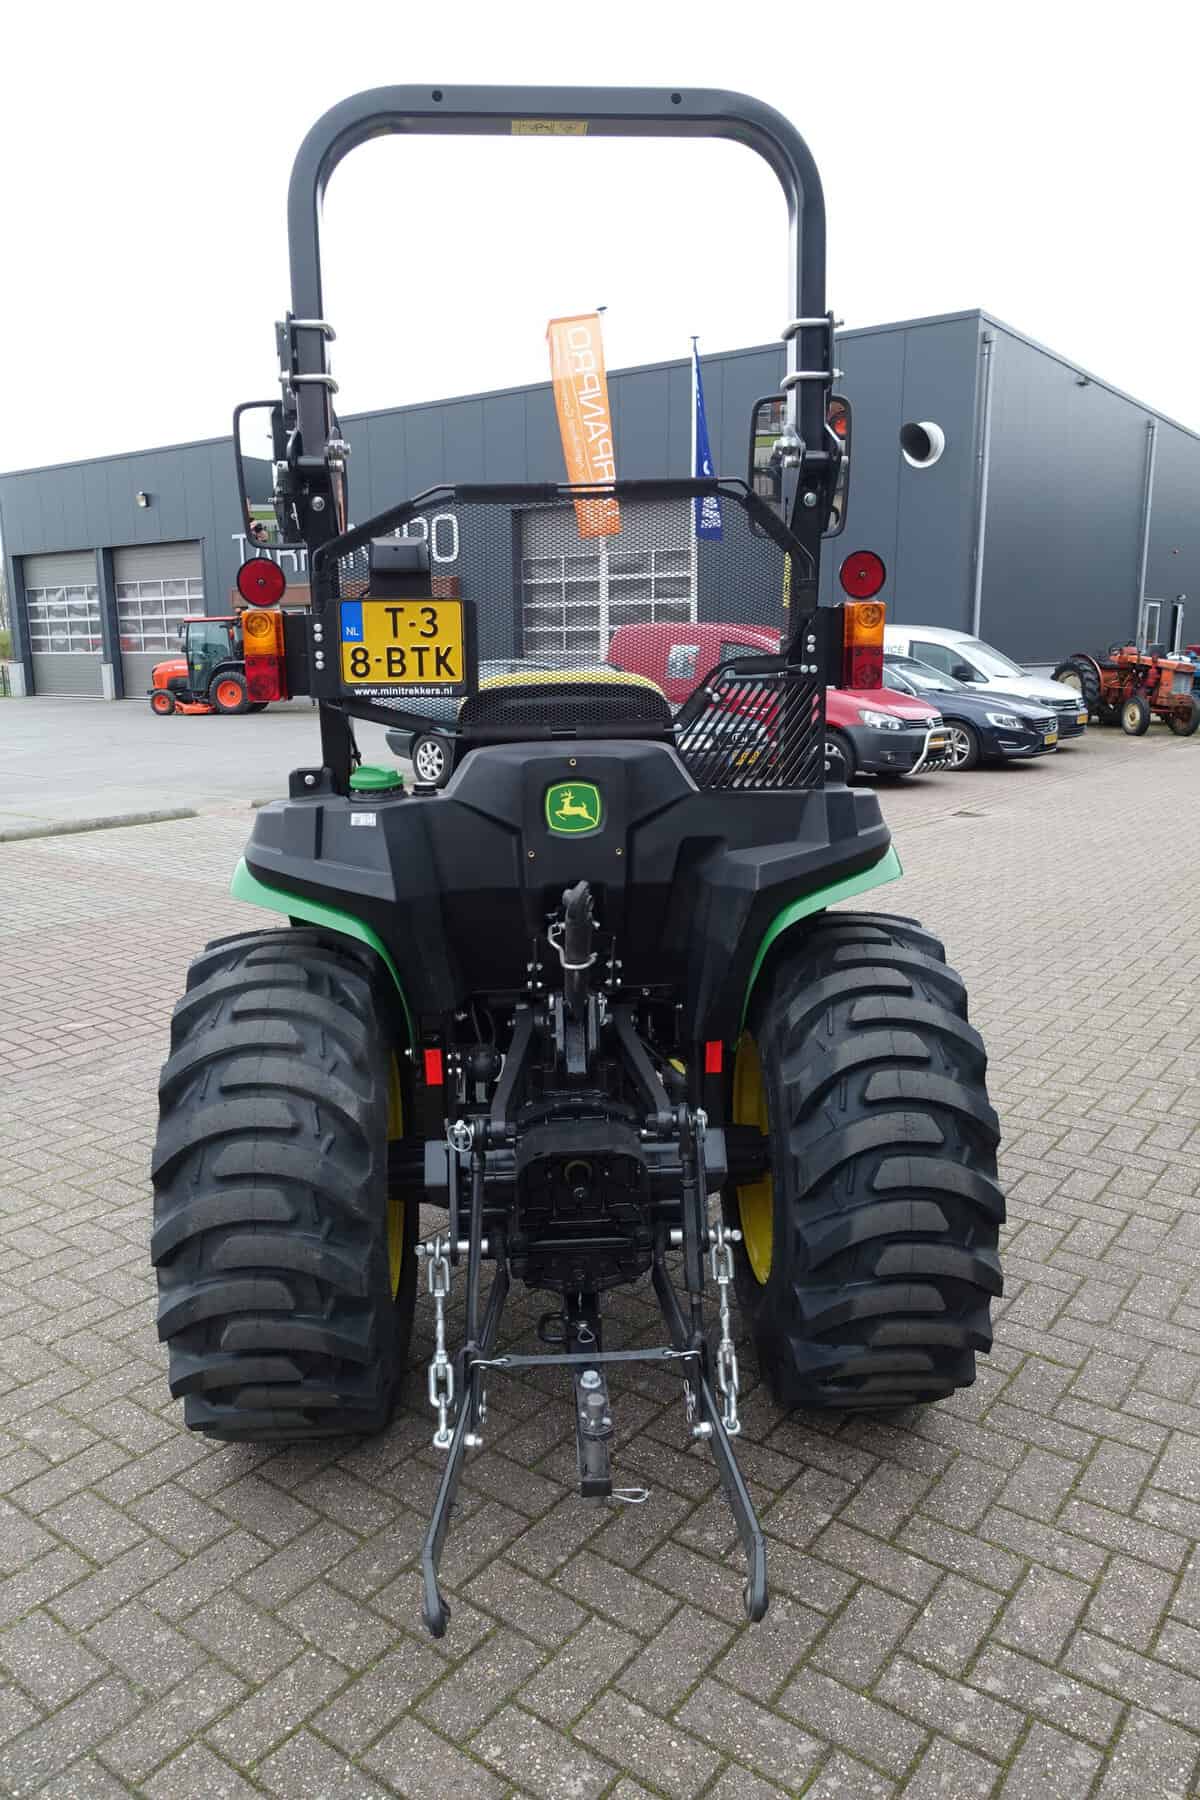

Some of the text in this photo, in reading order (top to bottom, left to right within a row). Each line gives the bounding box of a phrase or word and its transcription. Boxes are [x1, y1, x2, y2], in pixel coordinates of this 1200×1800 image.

[346, 626, 360, 636] NL
[384, 607, 438, 638] T-3
[350, 646, 456, 678] 8-BTK
[354, 686, 453, 696] www.minitrekkers.nl
